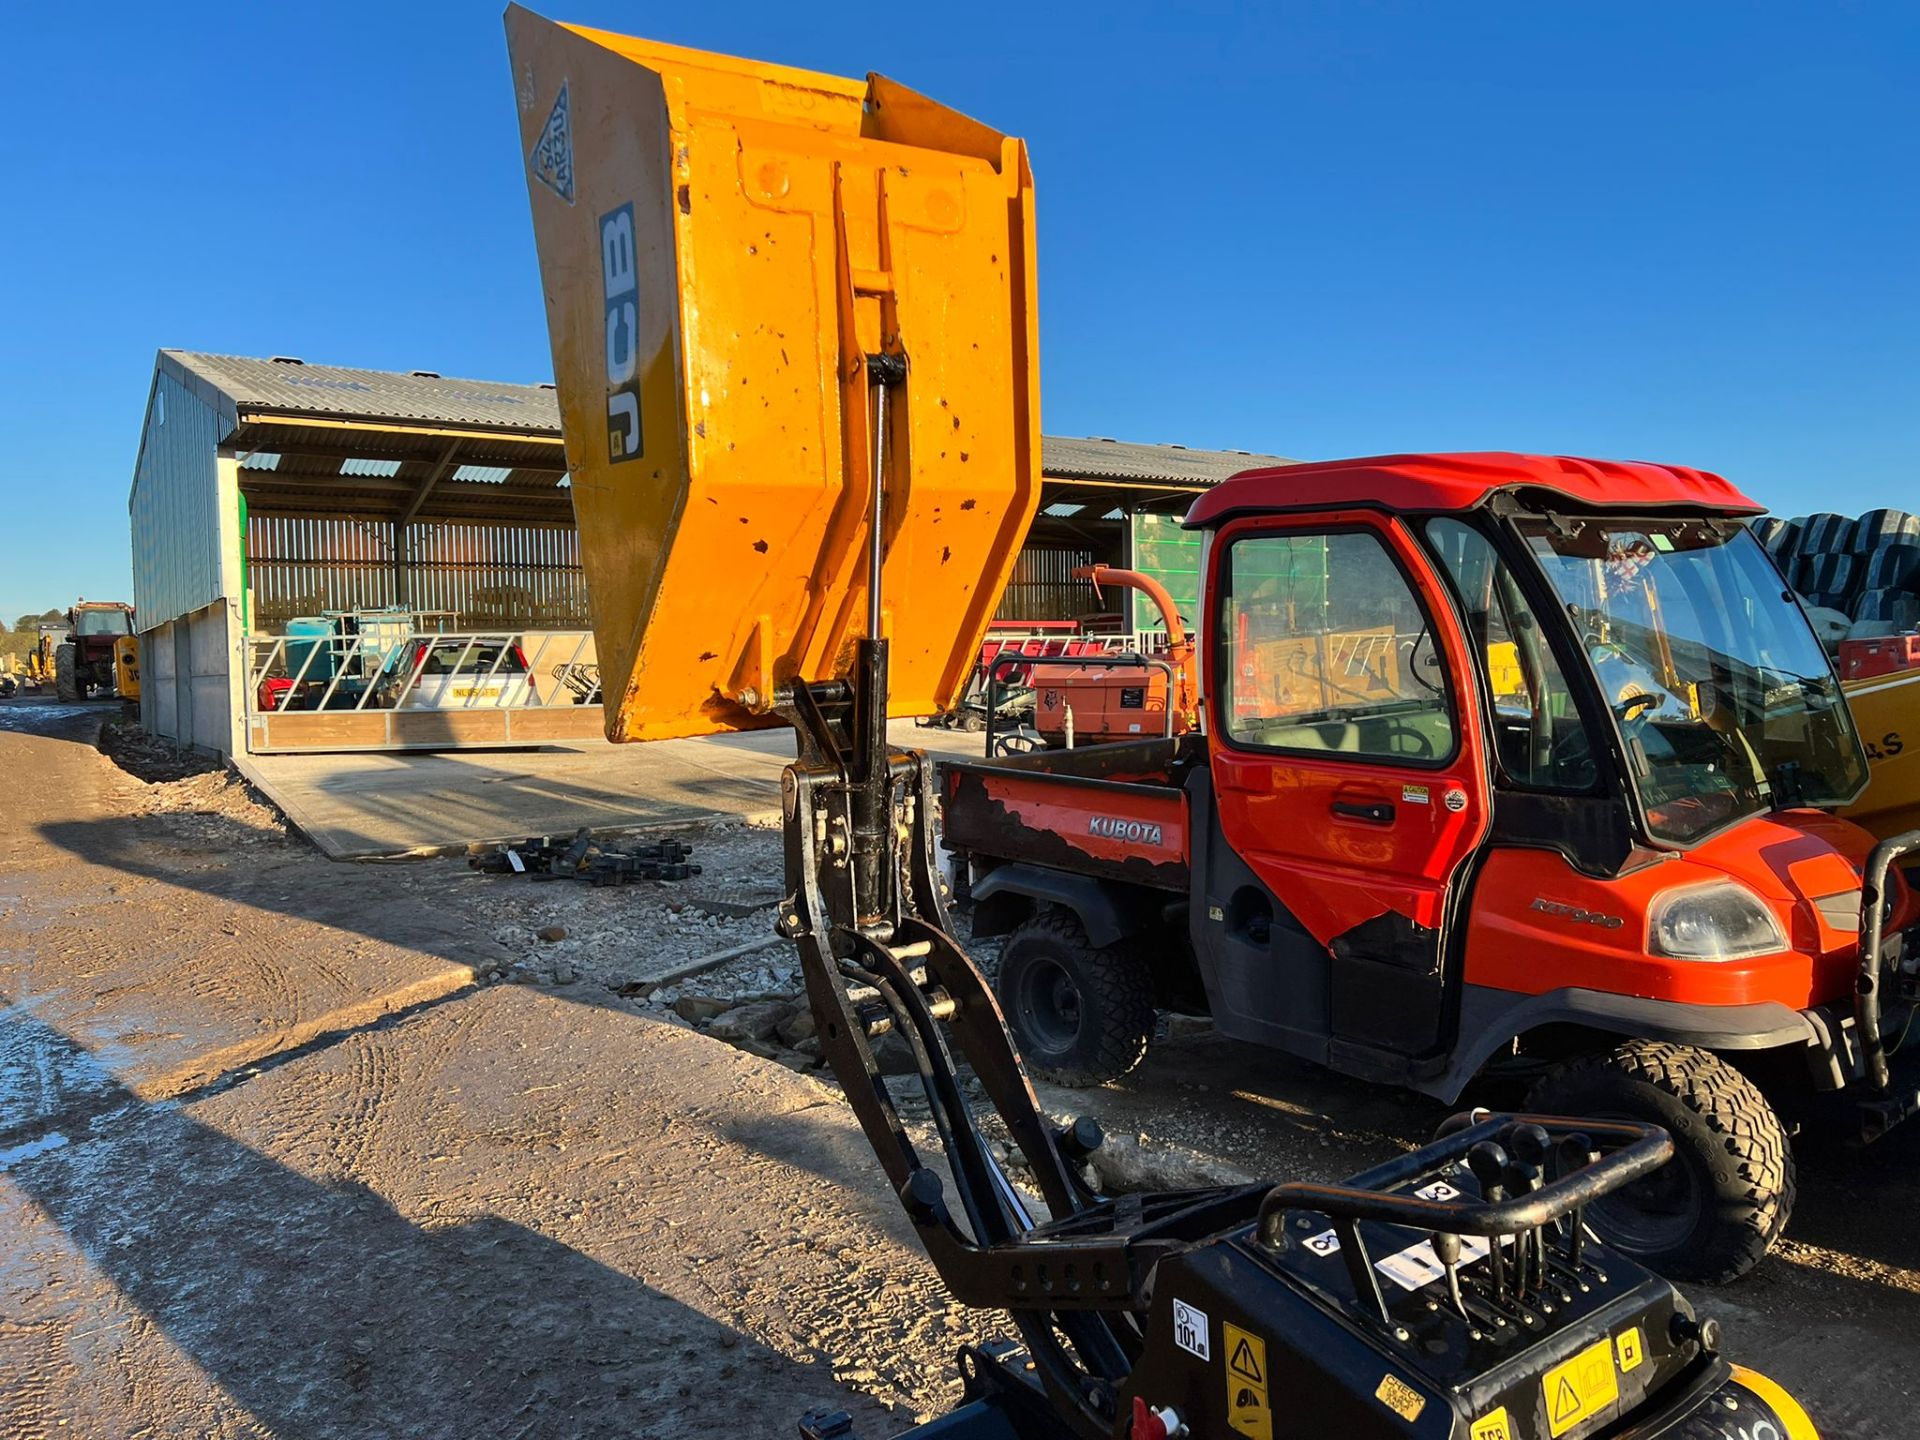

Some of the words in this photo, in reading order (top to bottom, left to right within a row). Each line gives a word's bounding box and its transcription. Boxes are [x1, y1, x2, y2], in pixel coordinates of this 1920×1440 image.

[603, 211, 640, 456] JCB
[128, 667, 140, 682] JC
[1088, 815, 1164, 846] KUBOTA
[1177, 1323, 1196, 1351] 101
[1386, 1375, 1424, 1406] CHECK
